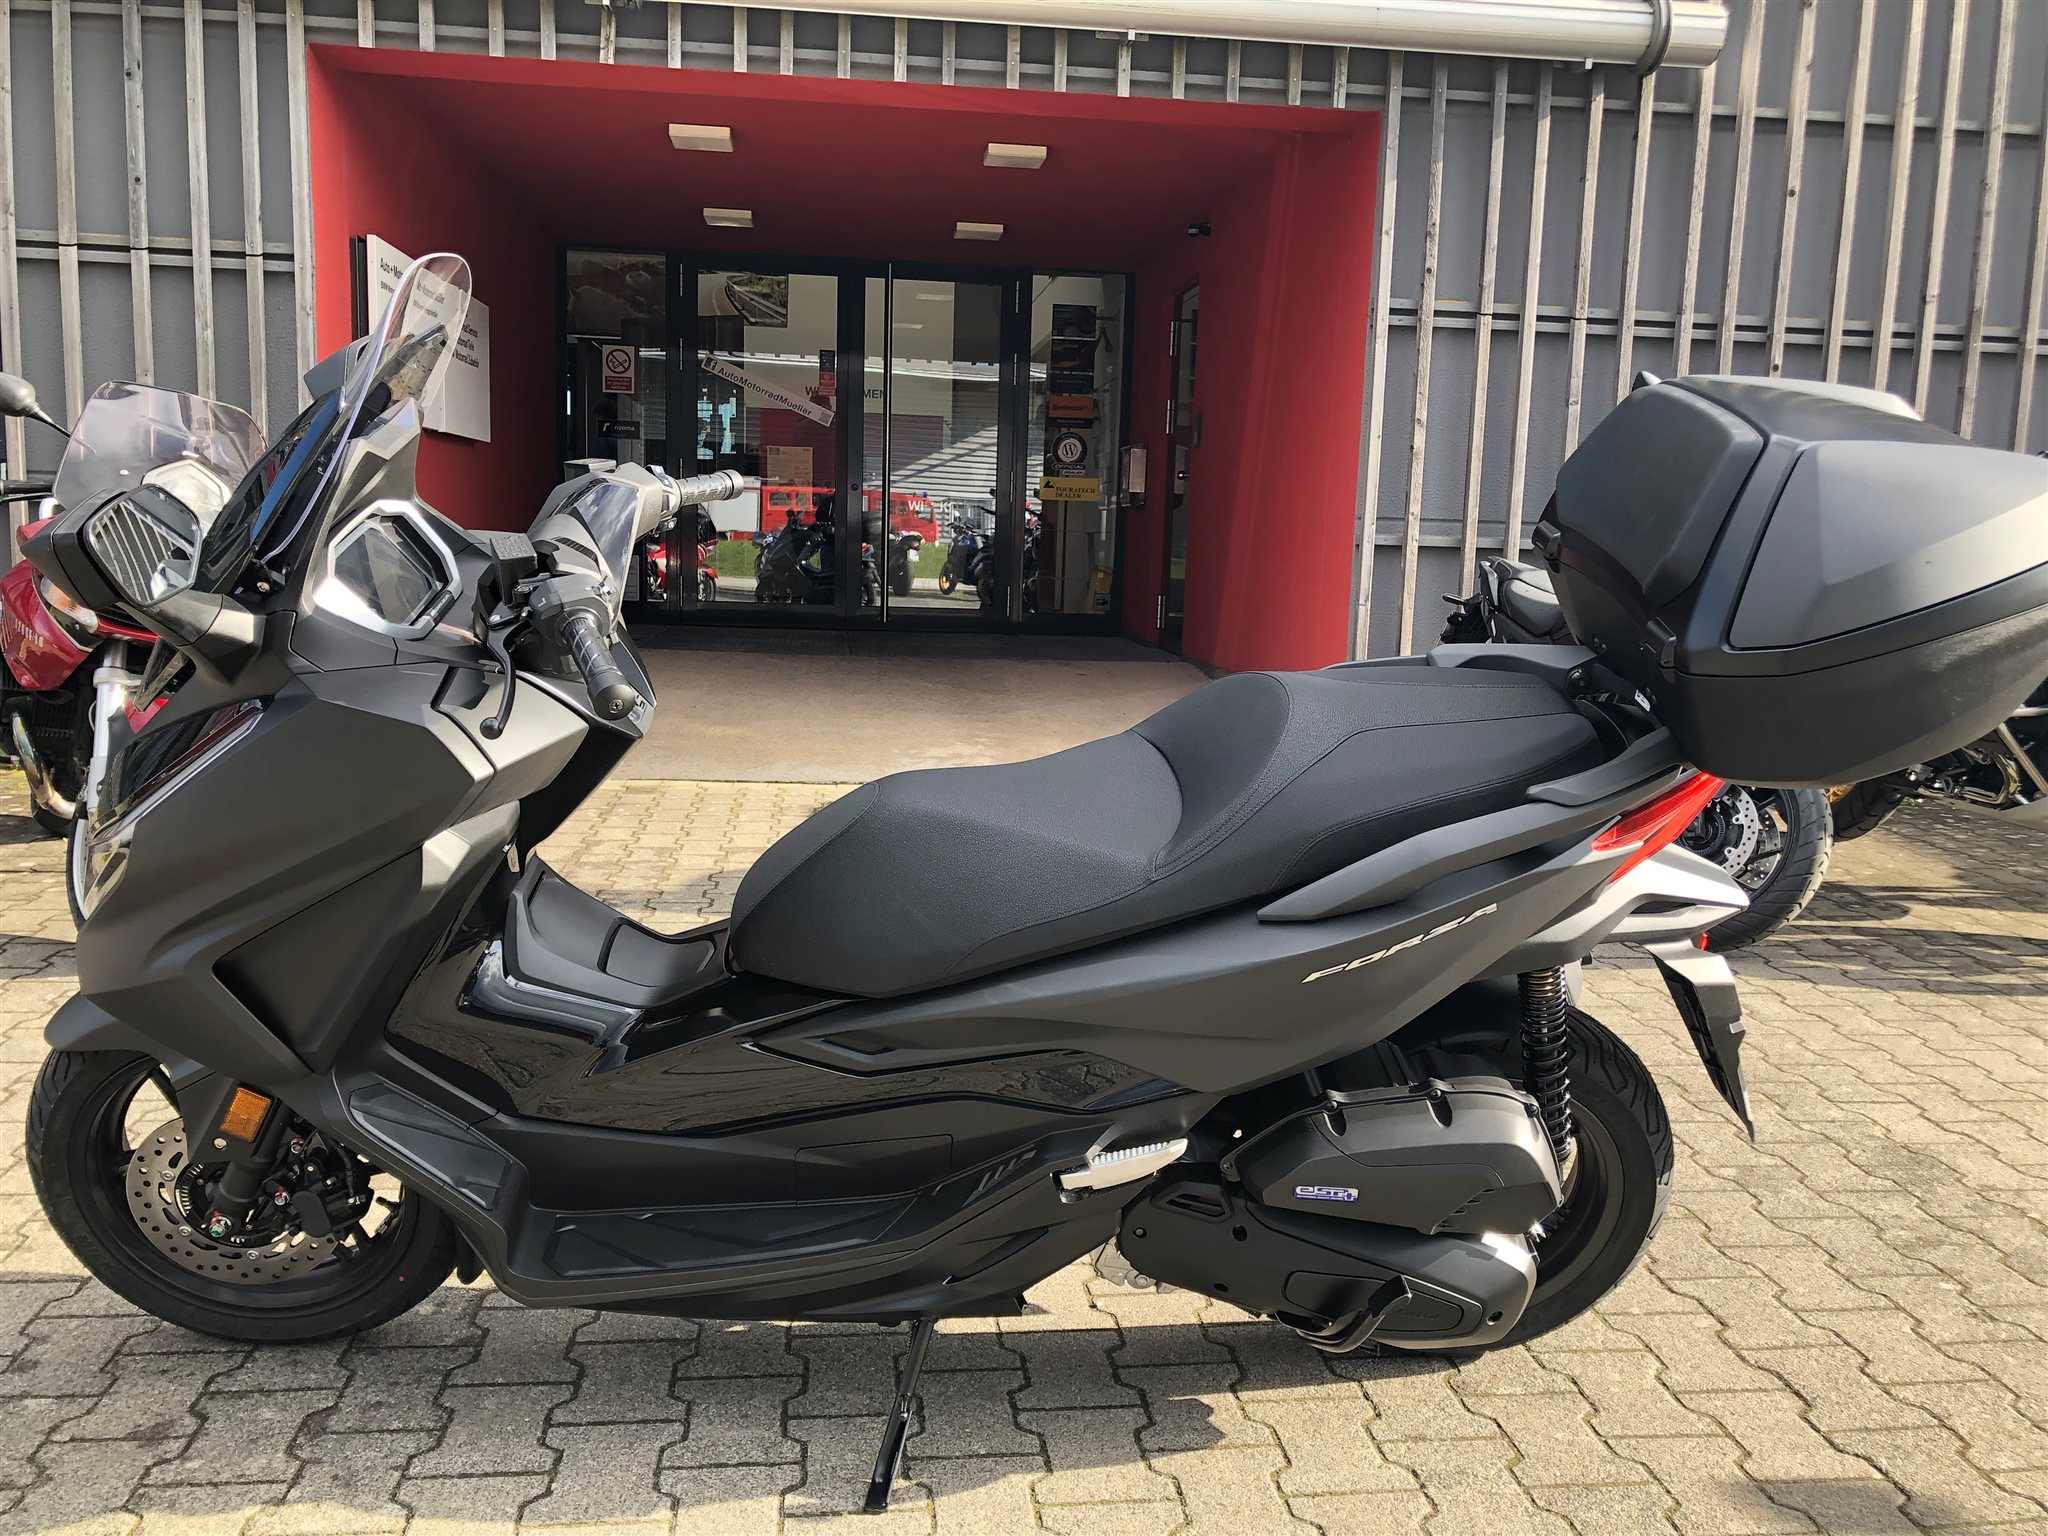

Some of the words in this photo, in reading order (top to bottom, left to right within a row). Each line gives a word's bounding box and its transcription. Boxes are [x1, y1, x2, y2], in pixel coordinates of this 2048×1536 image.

[718, 366, 812, 416] AutoMotorradMueller
[1056, 486, 1096, 494] TOURATECH
[1301, 903, 1498, 984] FORZA
